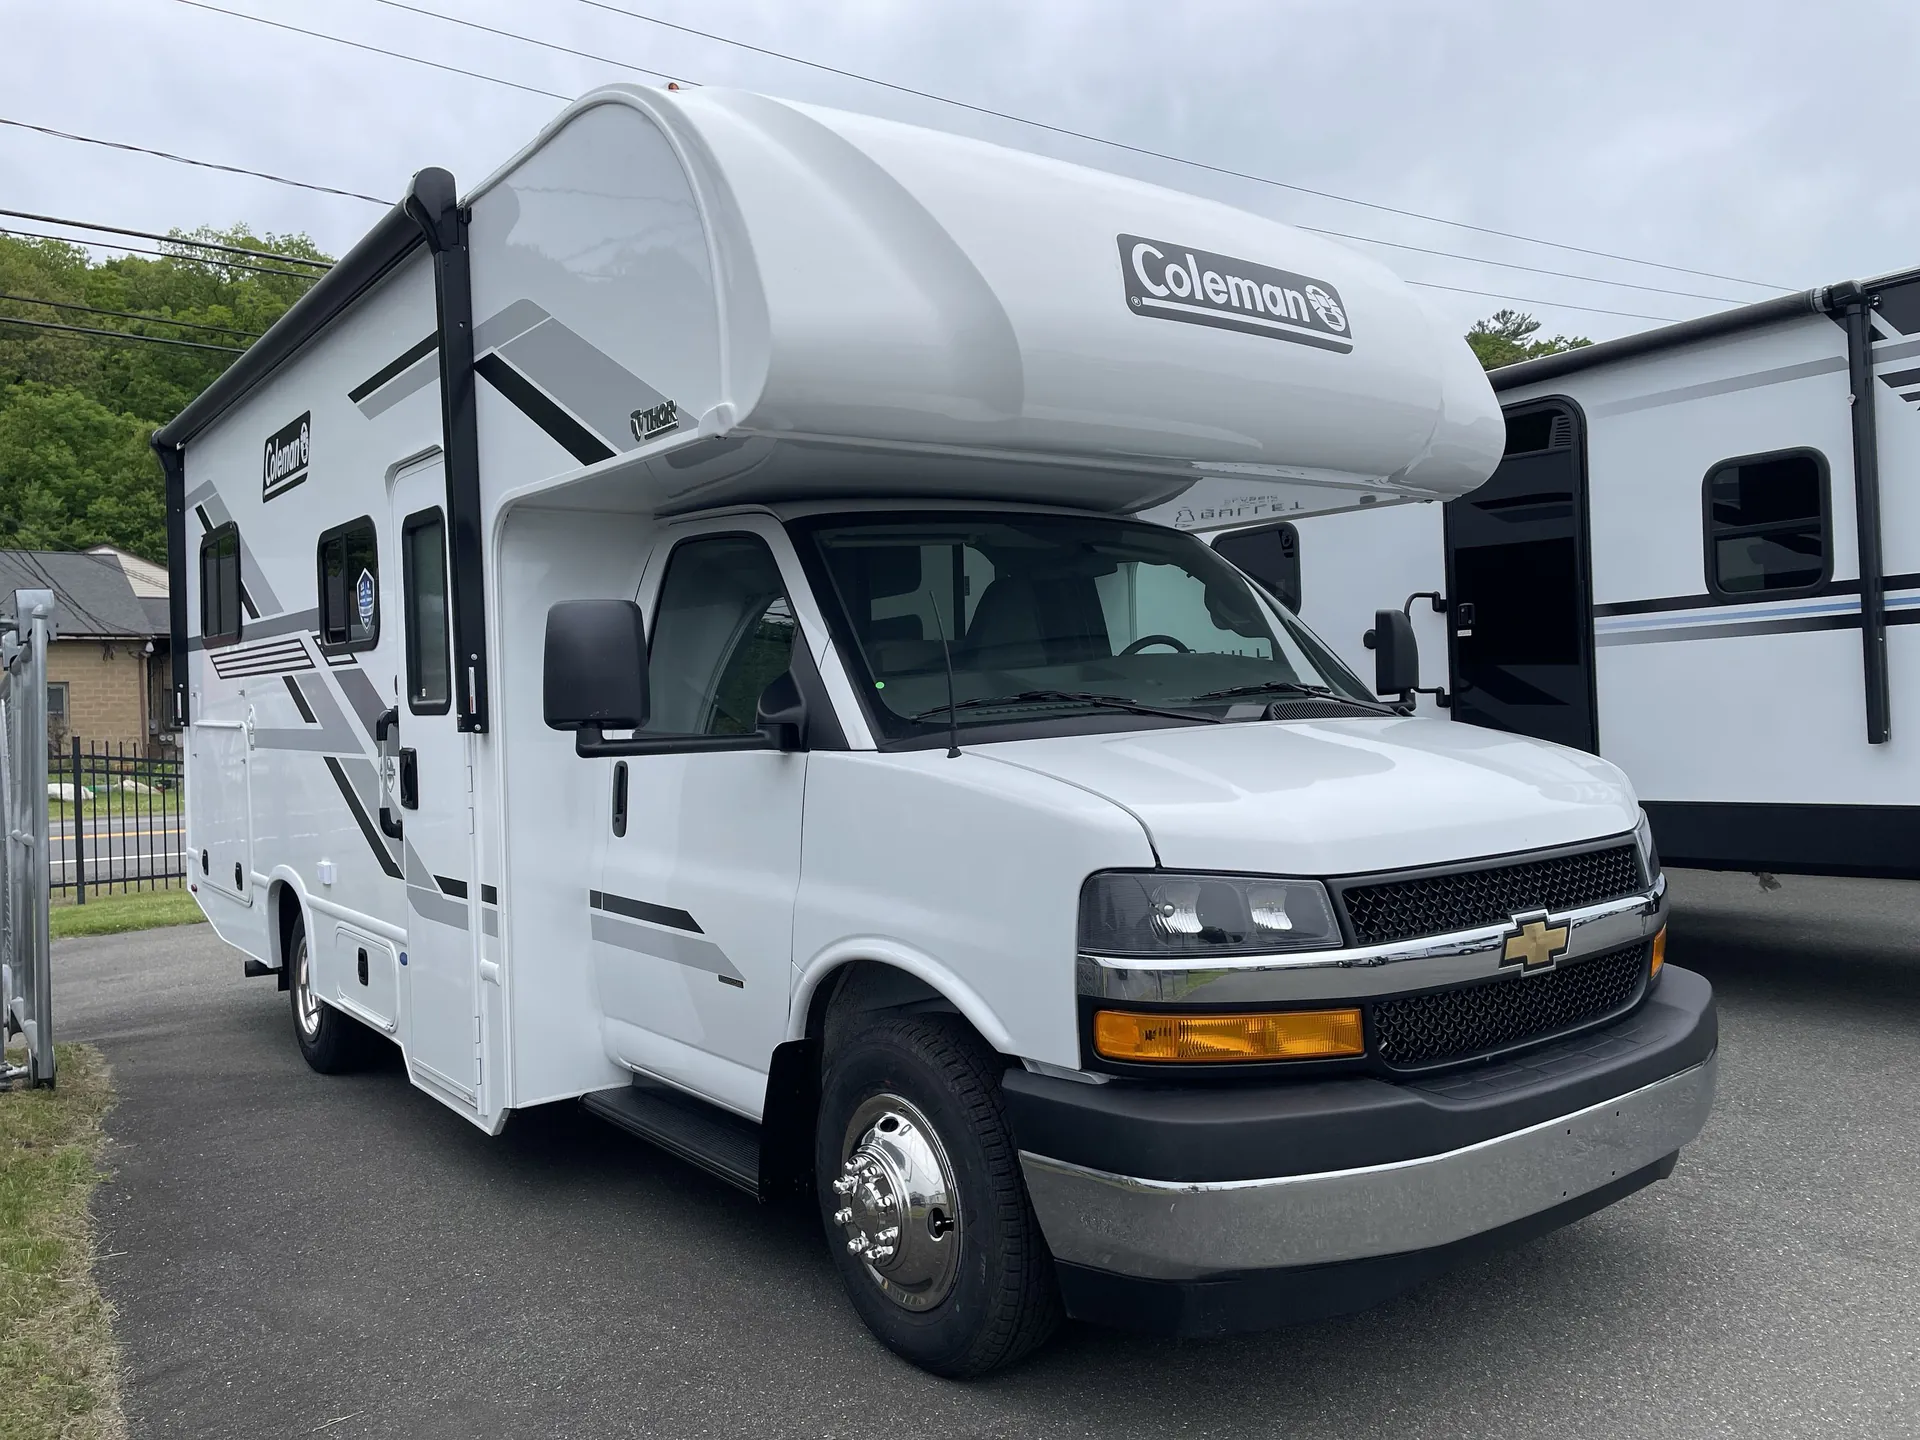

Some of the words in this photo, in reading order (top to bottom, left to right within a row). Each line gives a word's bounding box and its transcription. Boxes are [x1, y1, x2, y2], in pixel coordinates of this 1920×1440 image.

[1132, 243, 1310, 323] Coleman
[643, 399, 678, 432] THOR
[265, 438, 300, 487] Coleman
